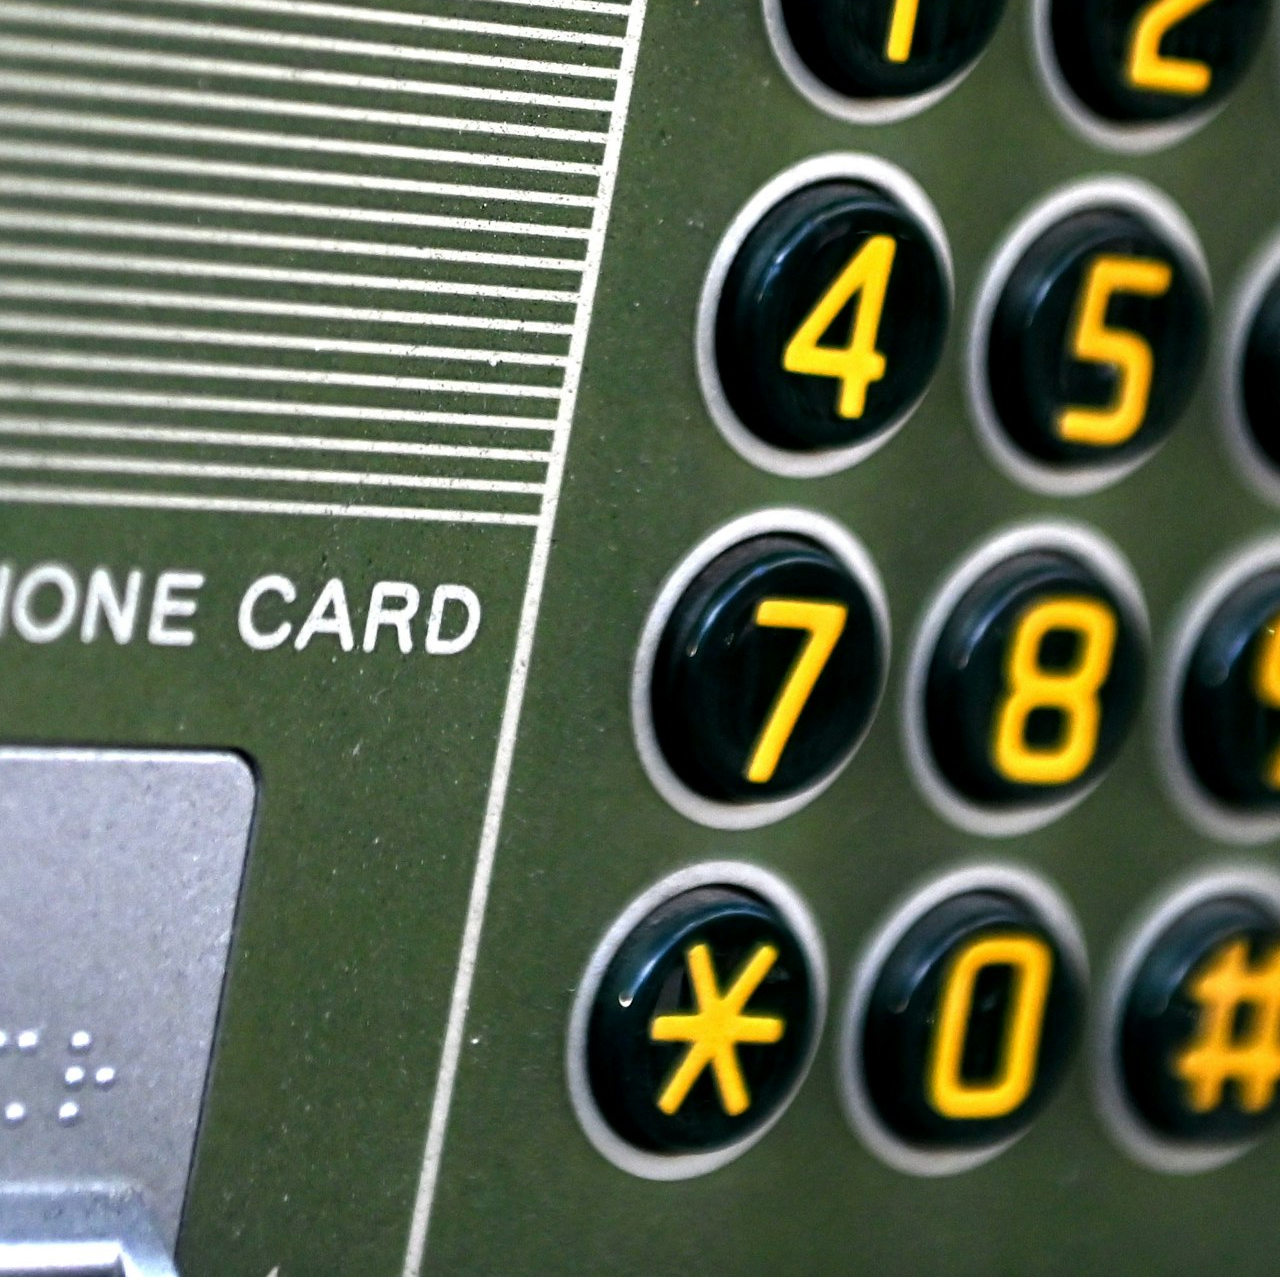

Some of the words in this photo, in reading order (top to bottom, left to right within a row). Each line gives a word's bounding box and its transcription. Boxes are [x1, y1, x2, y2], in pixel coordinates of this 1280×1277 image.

[784, 235, 895, 418] 4
[1058, 257, 1170, 444] 5
[237, 572, 482, 656] CARD
[747, 599, 846, 782] 7
[995, 599, 1114, 783] 8
[932, 937, 1050, 1117] 0
